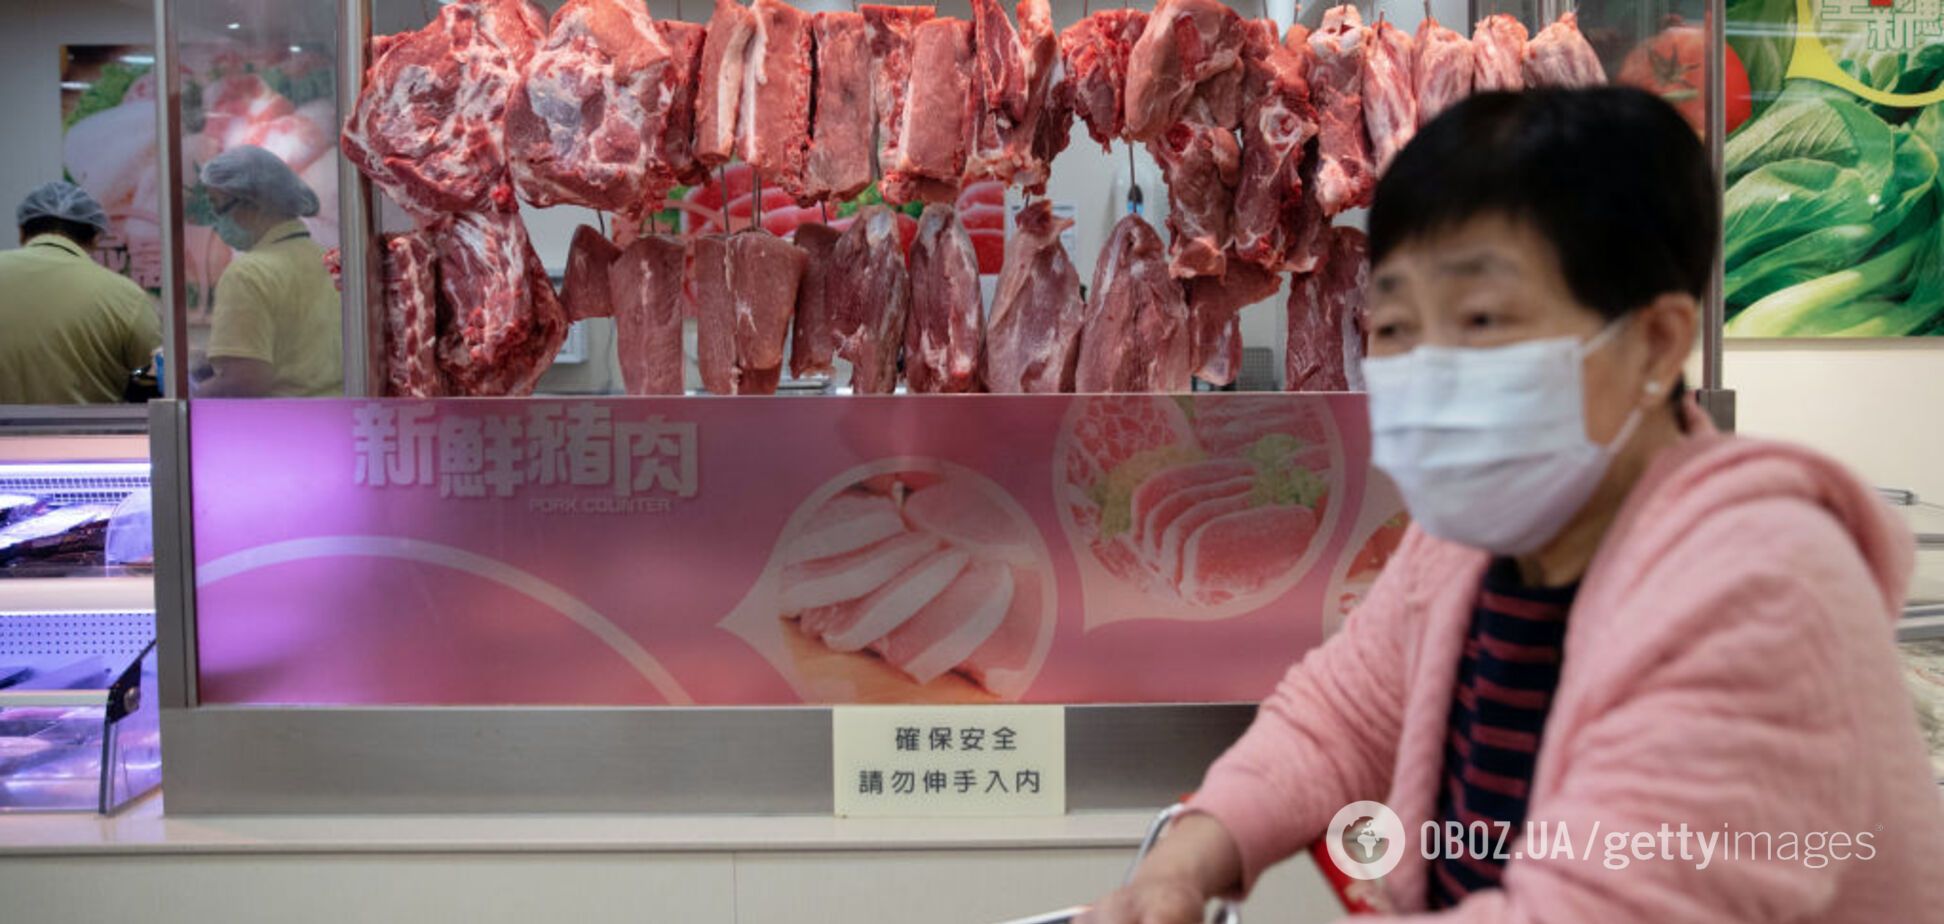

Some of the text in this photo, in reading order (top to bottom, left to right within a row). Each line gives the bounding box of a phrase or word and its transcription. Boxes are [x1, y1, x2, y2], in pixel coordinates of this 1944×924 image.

[352, 402, 699, 498] 新鮮豬肉
[530, 499, 671, 513] PORK COUNTER
[895, 726, 1017, 751] 確保安全
